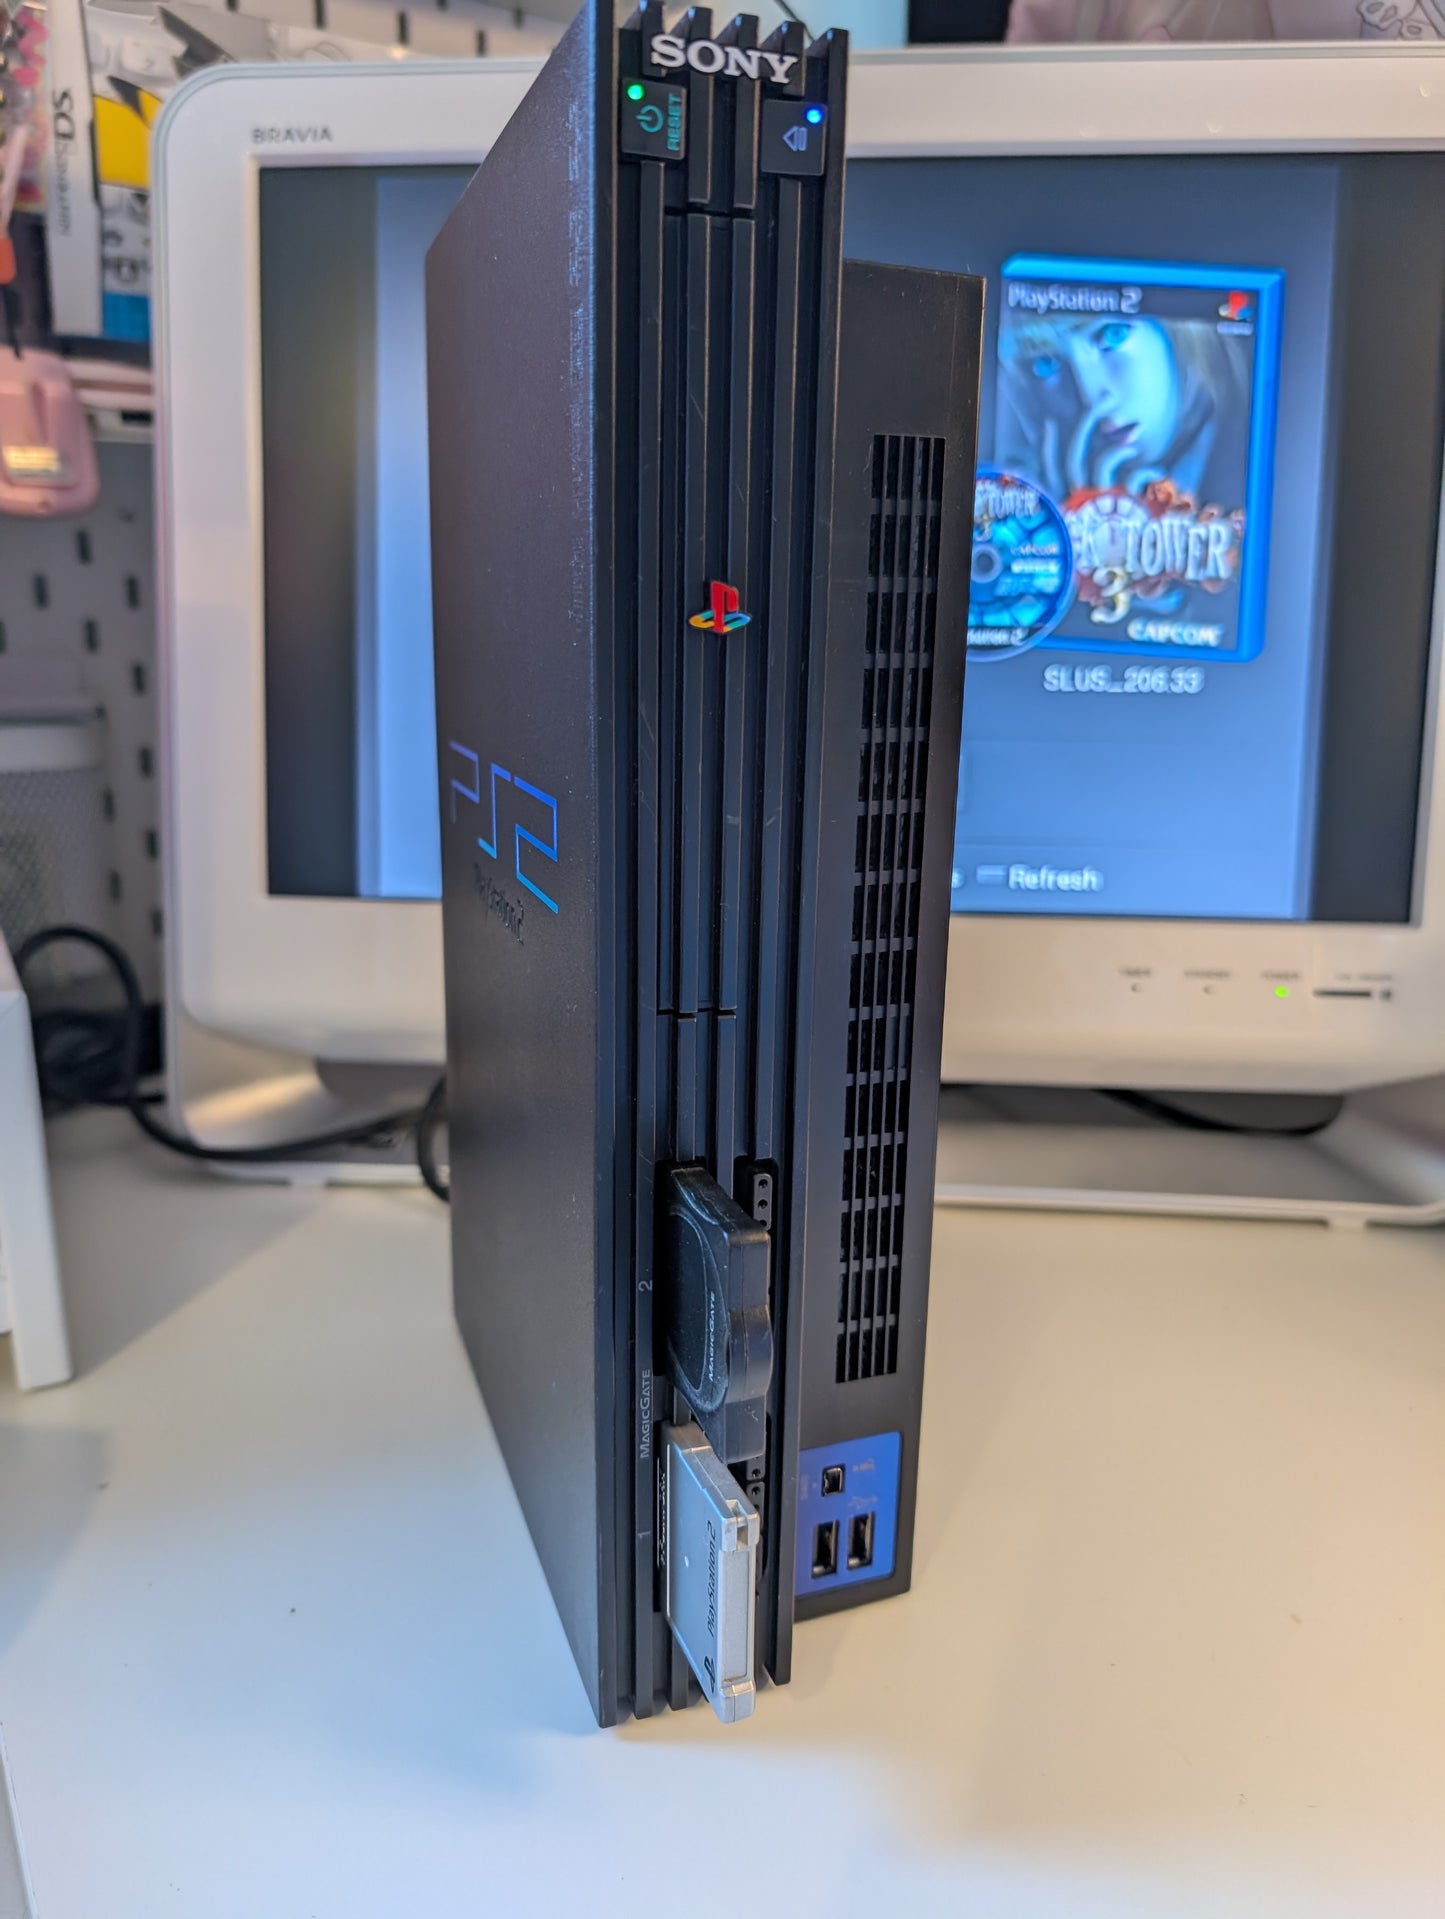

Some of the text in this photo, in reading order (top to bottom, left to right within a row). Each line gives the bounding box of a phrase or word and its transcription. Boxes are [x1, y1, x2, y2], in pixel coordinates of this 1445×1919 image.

[651, 34, 798, 84] SONY
[251, 127, 333, 144] BRAVIA
[667, 93, 682, 151] RESET
[1119, 513, 1231, 581] TOWER
[1090, 566, 1130, 623] 3
[1127, 617, 1224, 648] CAPCOM
[1008, 863, 1105, 892] Refresh
[638, 1279, 653, 1292] 2
